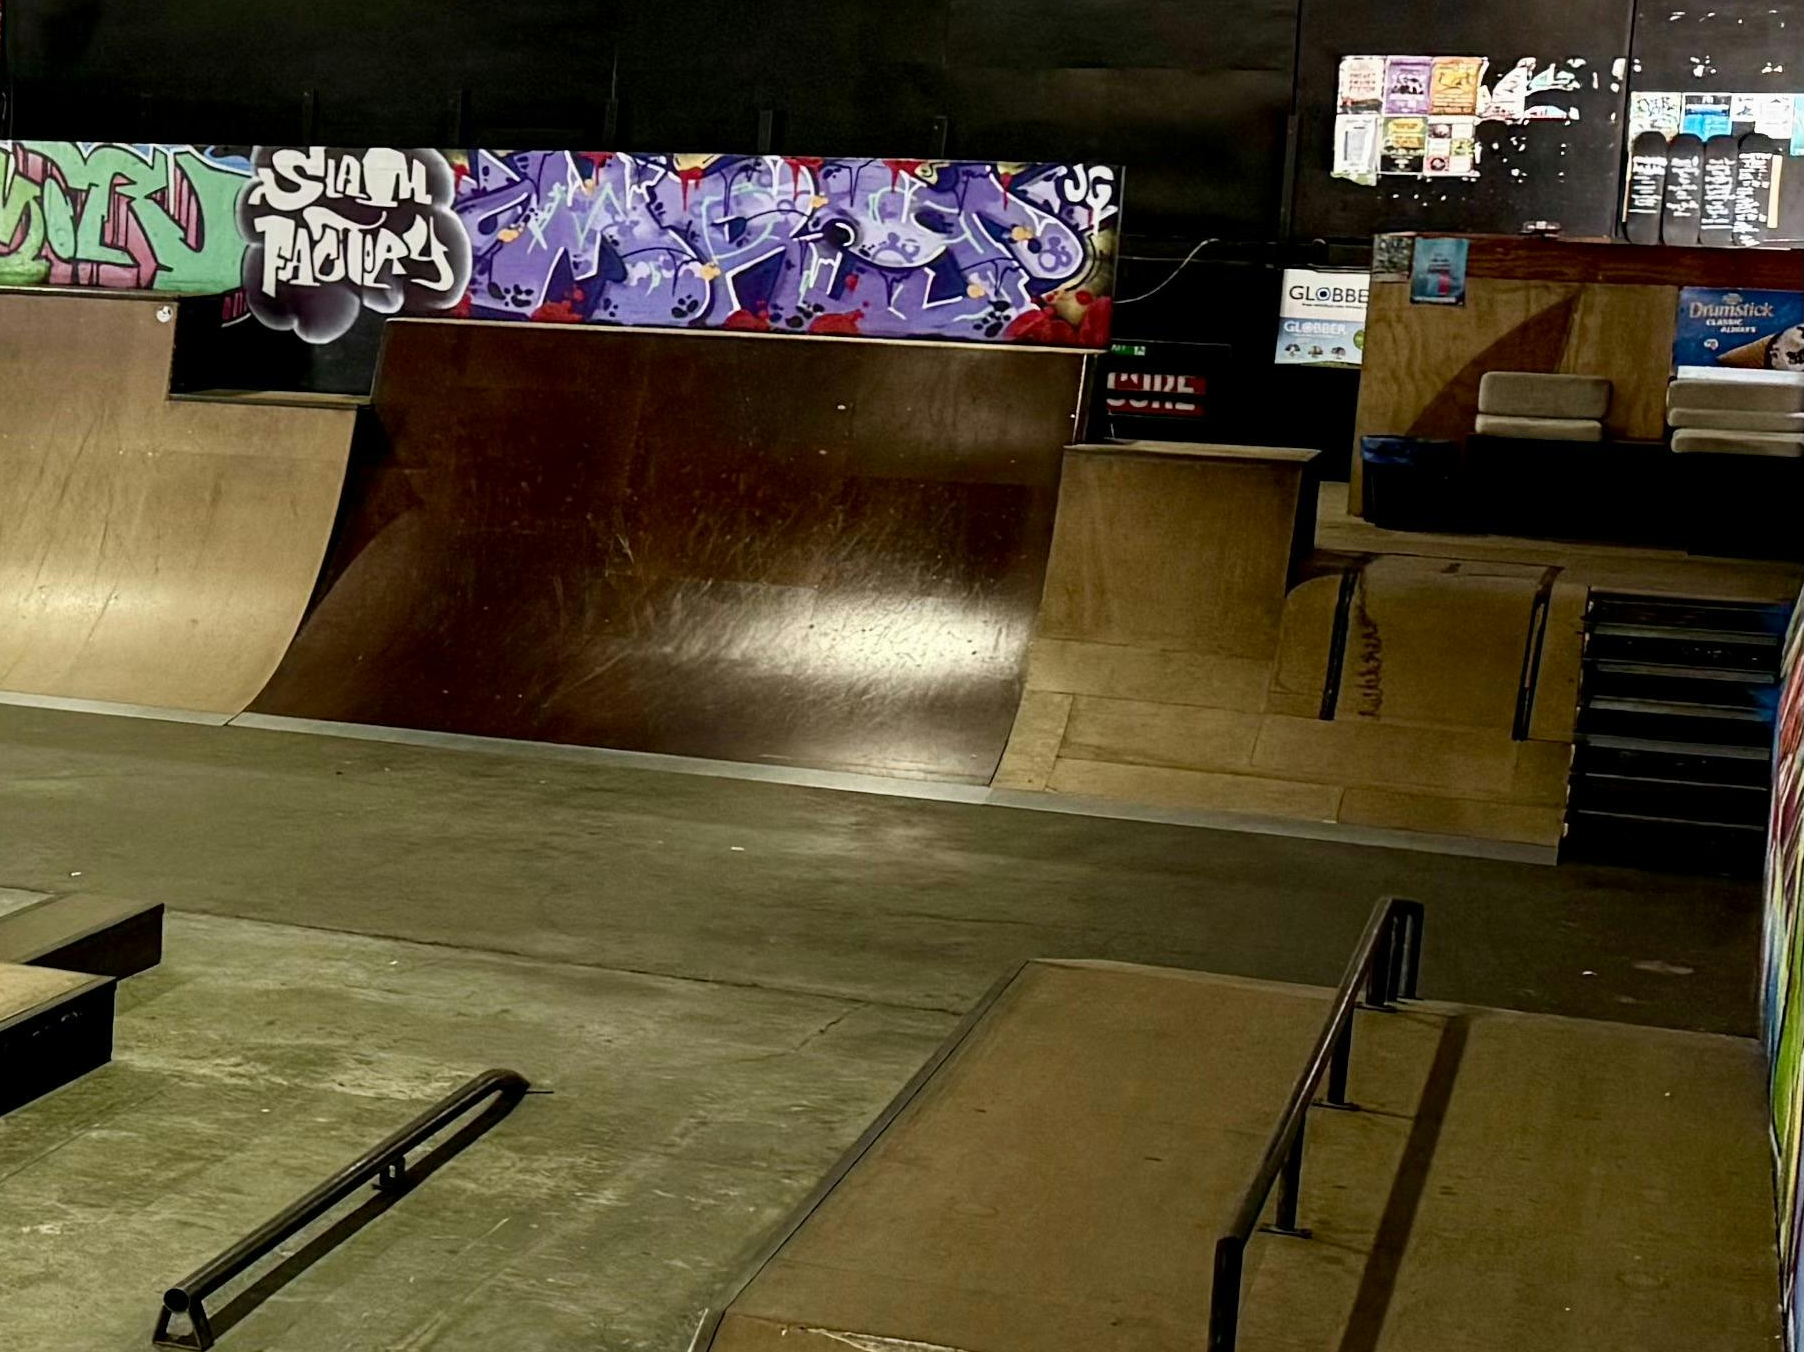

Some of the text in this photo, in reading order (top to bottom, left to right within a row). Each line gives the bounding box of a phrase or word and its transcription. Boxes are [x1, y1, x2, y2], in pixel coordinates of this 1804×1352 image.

[248, 147, 432, 211] SLAM
[254, 206, 454, 297] FACTORY
[1289, 285, 1369, 304] GLOBBE
[1689, 301, 1774, 318] Drumstick
[1705, 318, 1743, 326] CLASSIC
